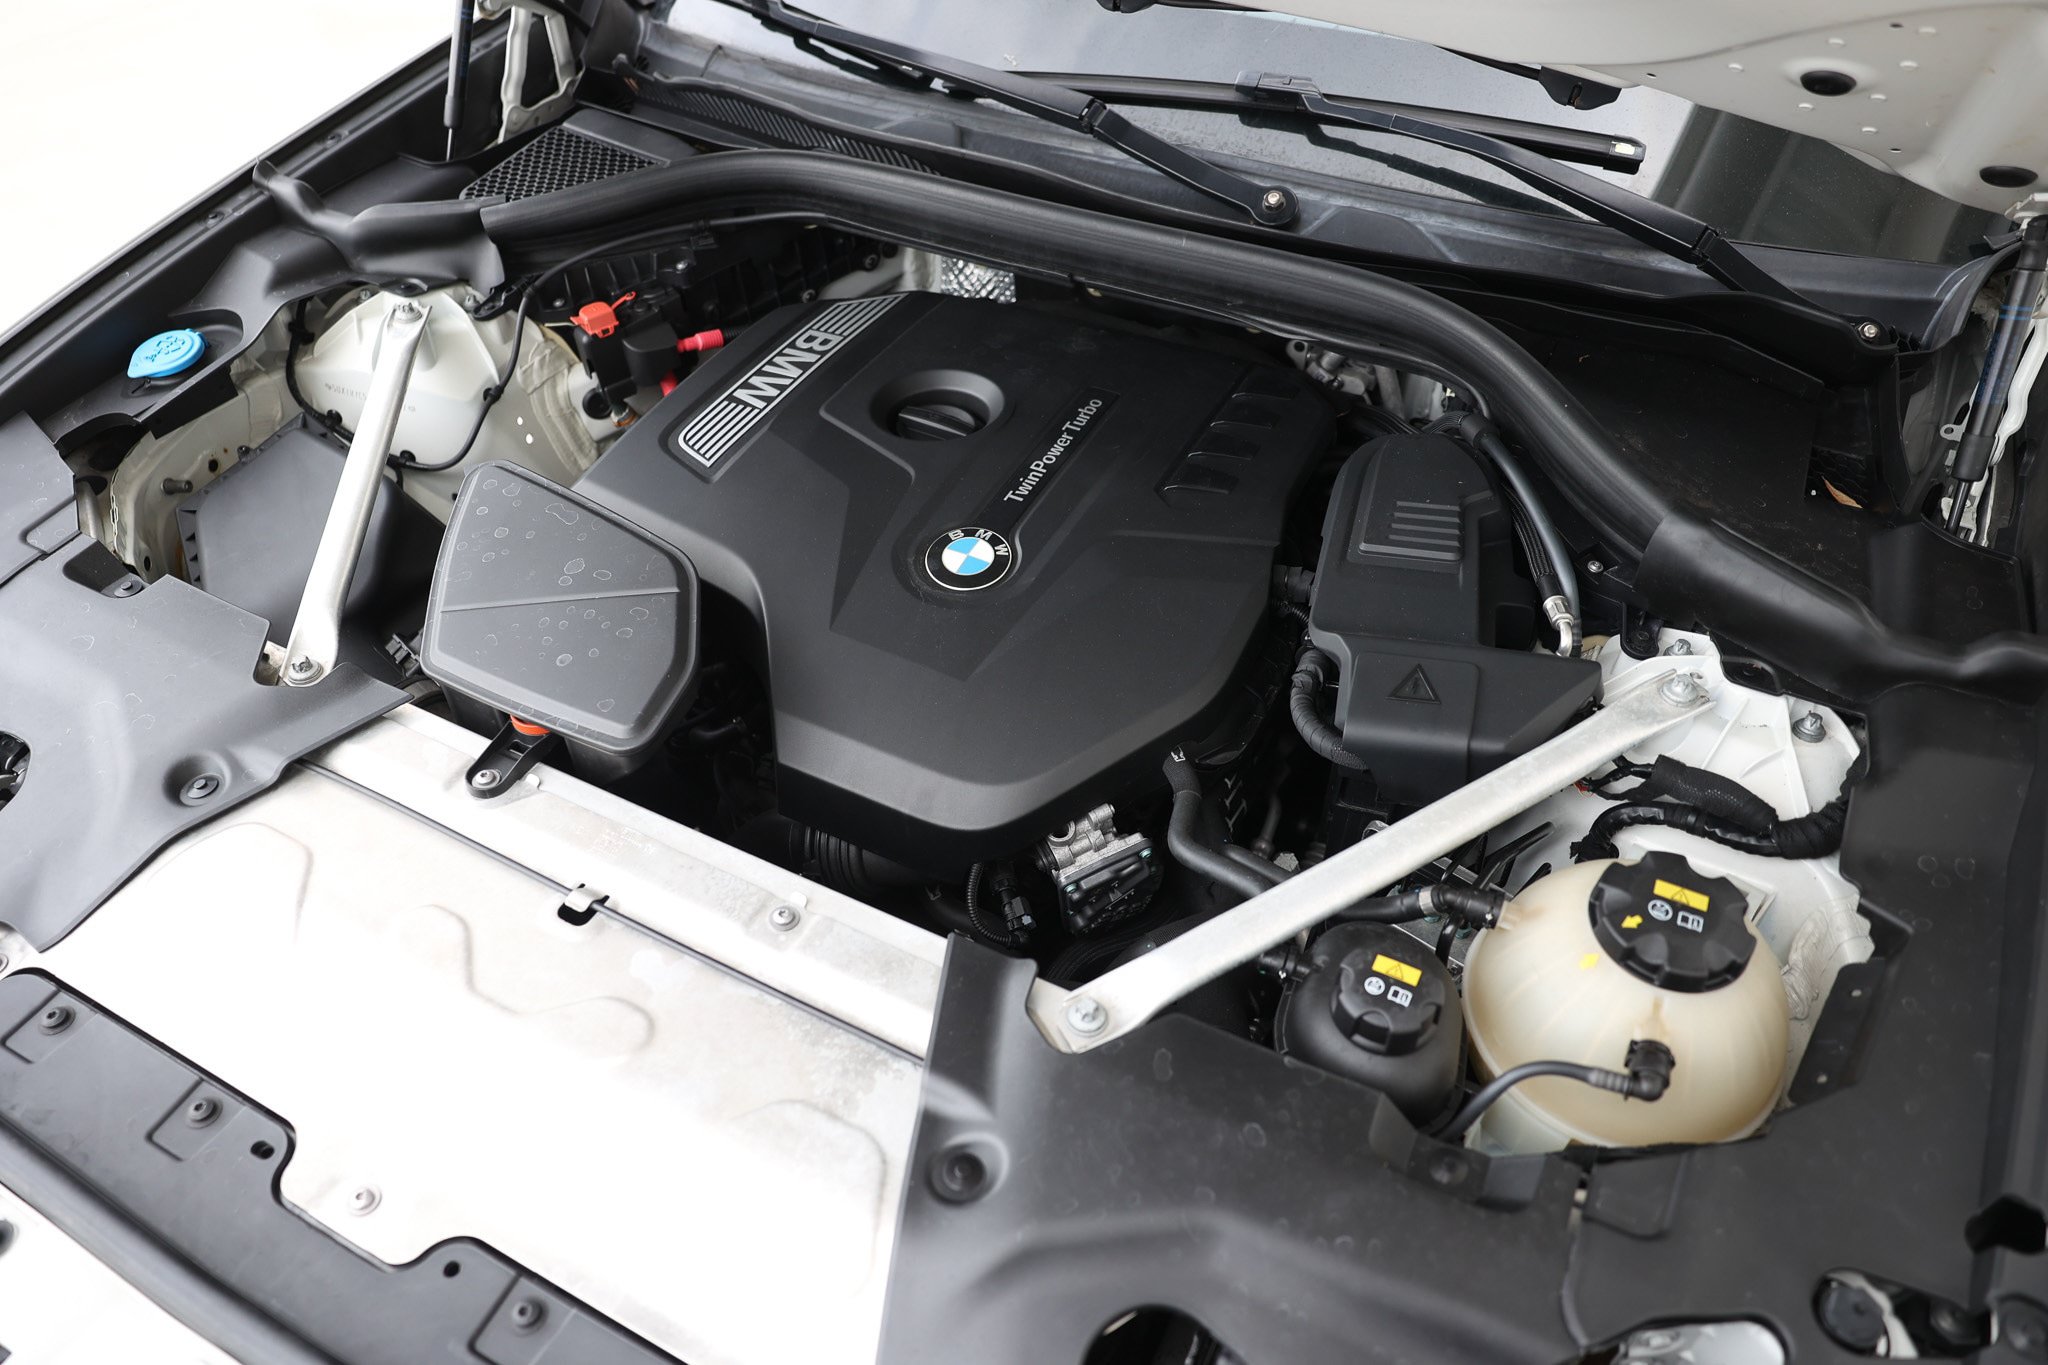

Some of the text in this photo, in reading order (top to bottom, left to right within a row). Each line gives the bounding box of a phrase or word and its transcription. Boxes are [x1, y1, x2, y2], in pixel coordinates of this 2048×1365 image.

[733, 329, 845, 410] BMW
[1003, 399, 1103, 502] TwinPower Turbo
[948, 529, 1009, 556] BMW
